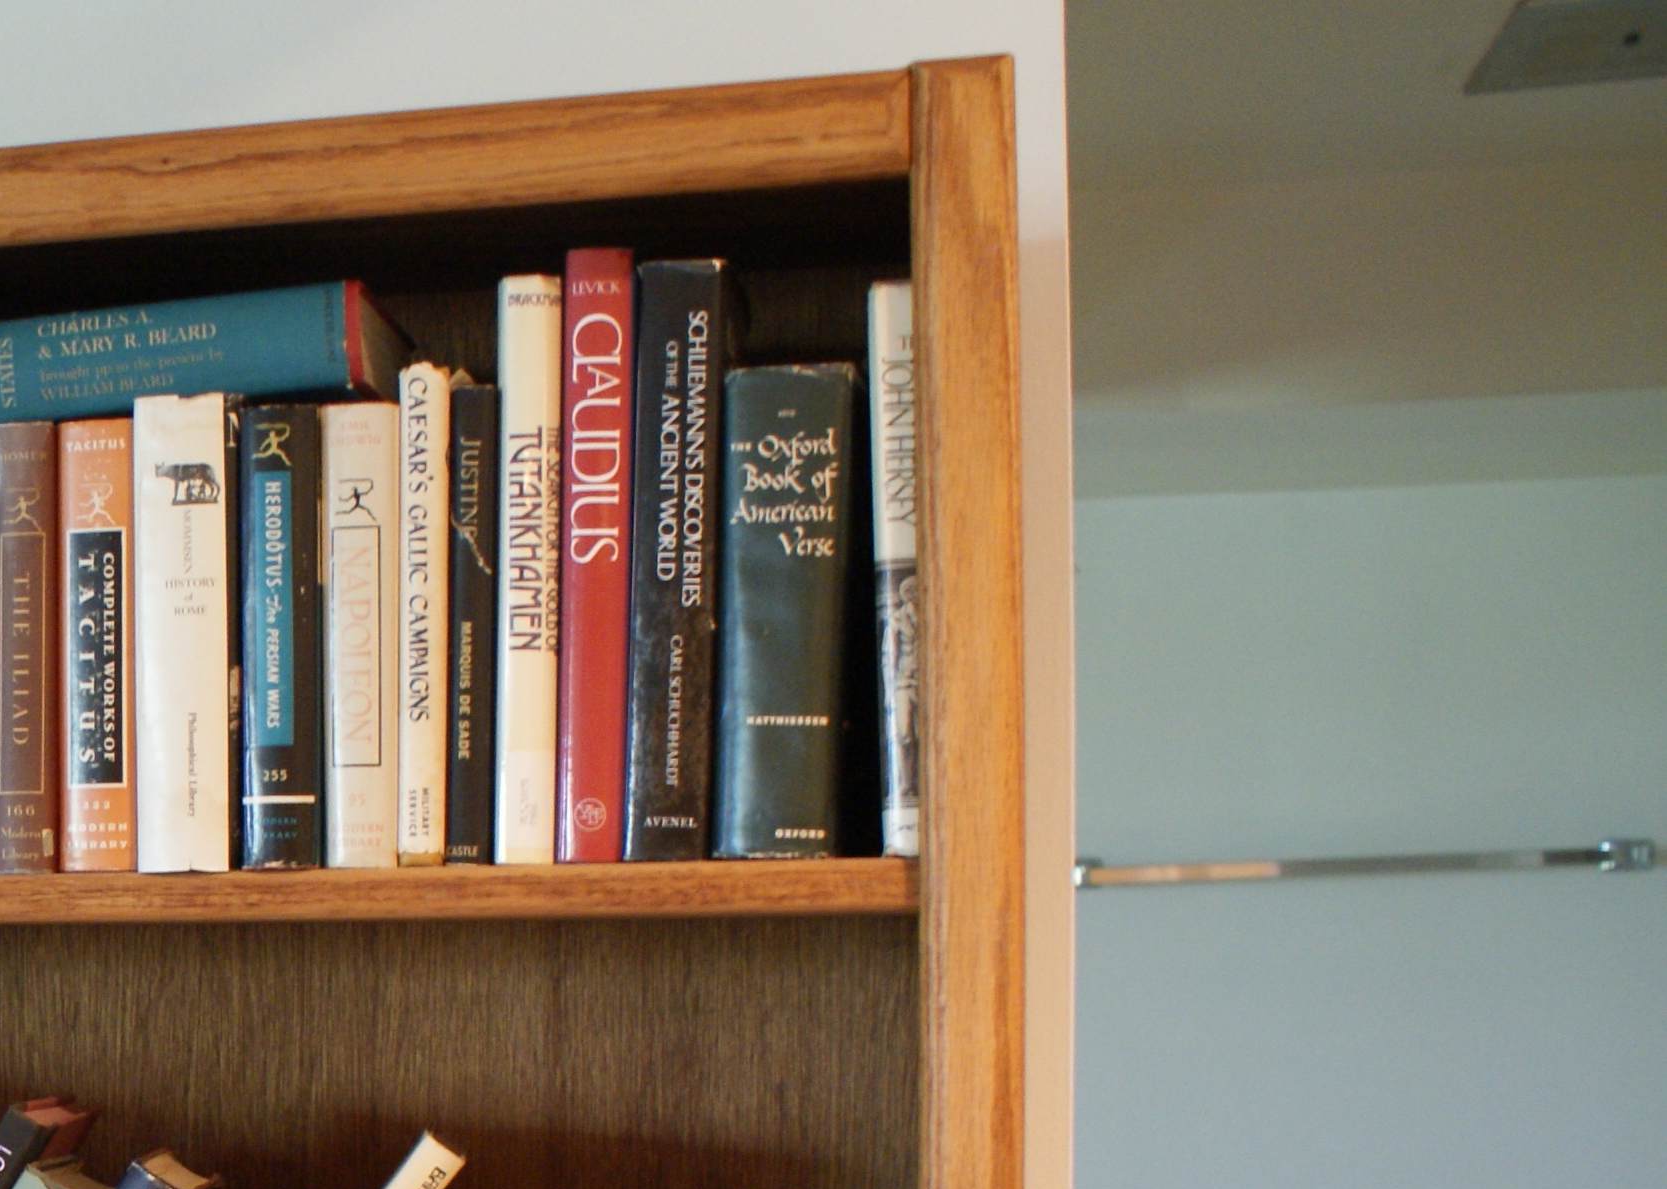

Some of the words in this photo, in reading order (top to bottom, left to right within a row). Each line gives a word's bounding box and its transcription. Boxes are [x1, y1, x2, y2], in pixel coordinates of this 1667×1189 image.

[572, 279, 622, 296] LEVICK
[37, 314, 130, 337] CHARLES
[61, 335, 115, 357] MARY
[148, 323, 217, 345] BEARD
[41, 380, 118, 402] WILLIAM
[120, 374, 176, 394] BEARD
[881, 357, 916, 428] JOHN
[66, 440, 127, 452] TACITUS
[406, 377, 435, 495] CAESAR'S
[570, 313, 624, 564] CLAUDIUS
[659, 393, 681, 495] ANCIENT
[757, 426, 837, 467] Oxford
[728, 497, 837, 525] American
[741, 462, 806, 495] Book
[811, 461, 841, 505] of
[884, 434, 917, 528] HERSEY
[407, 504, 429, 584] GALLIC
[656, 497, 679, 582] WORLD
[680, 472, 707, 607] DISCOVERIES
[777, 525, 836, 558] Verse
[12, 571, 30, 638] THE
[102, 551, 115, 656] COMPLETE
[165, 577, 216, 590] HISTORY
[174, 604, 208, 616] ROME
[78, 549, 97, 764] TACITUS
[266, 628, 281, 684] PERSIAN
[338, 545, 373, 745] NAPOLEON
[407, 594, 430, 722] CAMPAIGNS
[460, 621, 473, 690] MARQUIS
[12, 653, 30, 746] ILIAD
[103, 660, 116, 733] WORKS
[266, 688, 281, 729] WARS
[103, 735, 116, 763] OF
[458, 720, 471, 760] SADE
[642, 815, 698, 828] AVENEL
